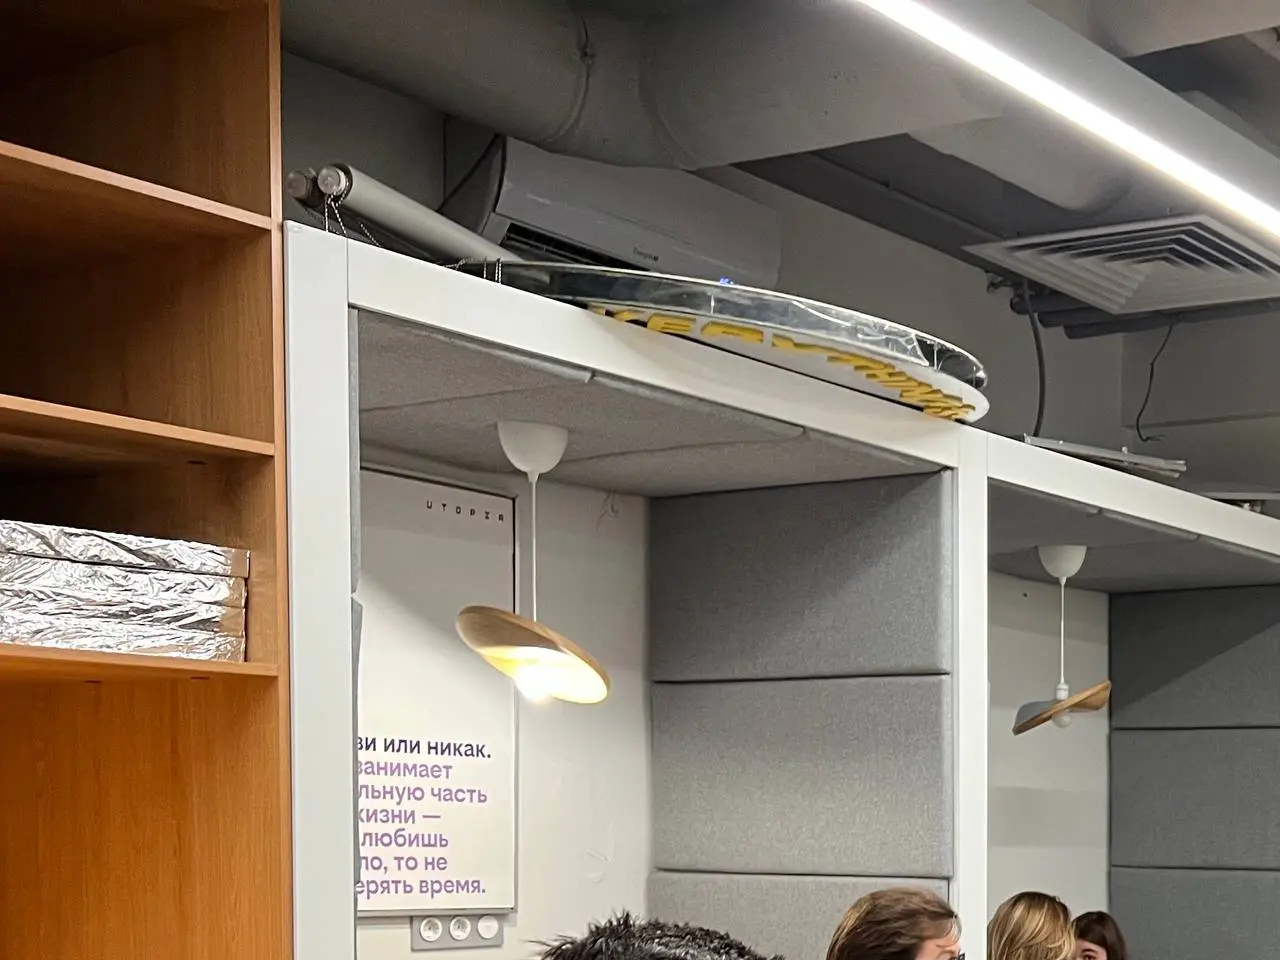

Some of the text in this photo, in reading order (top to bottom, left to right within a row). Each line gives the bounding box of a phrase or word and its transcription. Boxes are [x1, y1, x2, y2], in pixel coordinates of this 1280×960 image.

[384, 737, 421, 754] или
[427, 741, 491, 759] никак.
[358, 784, 488, 806] льную часть
[361, 828, 449, 848] любишь
[393, 856, 418, 871] то
[424, 856, 448, 871] не
[354, 879, 486, 900] ерять время.
